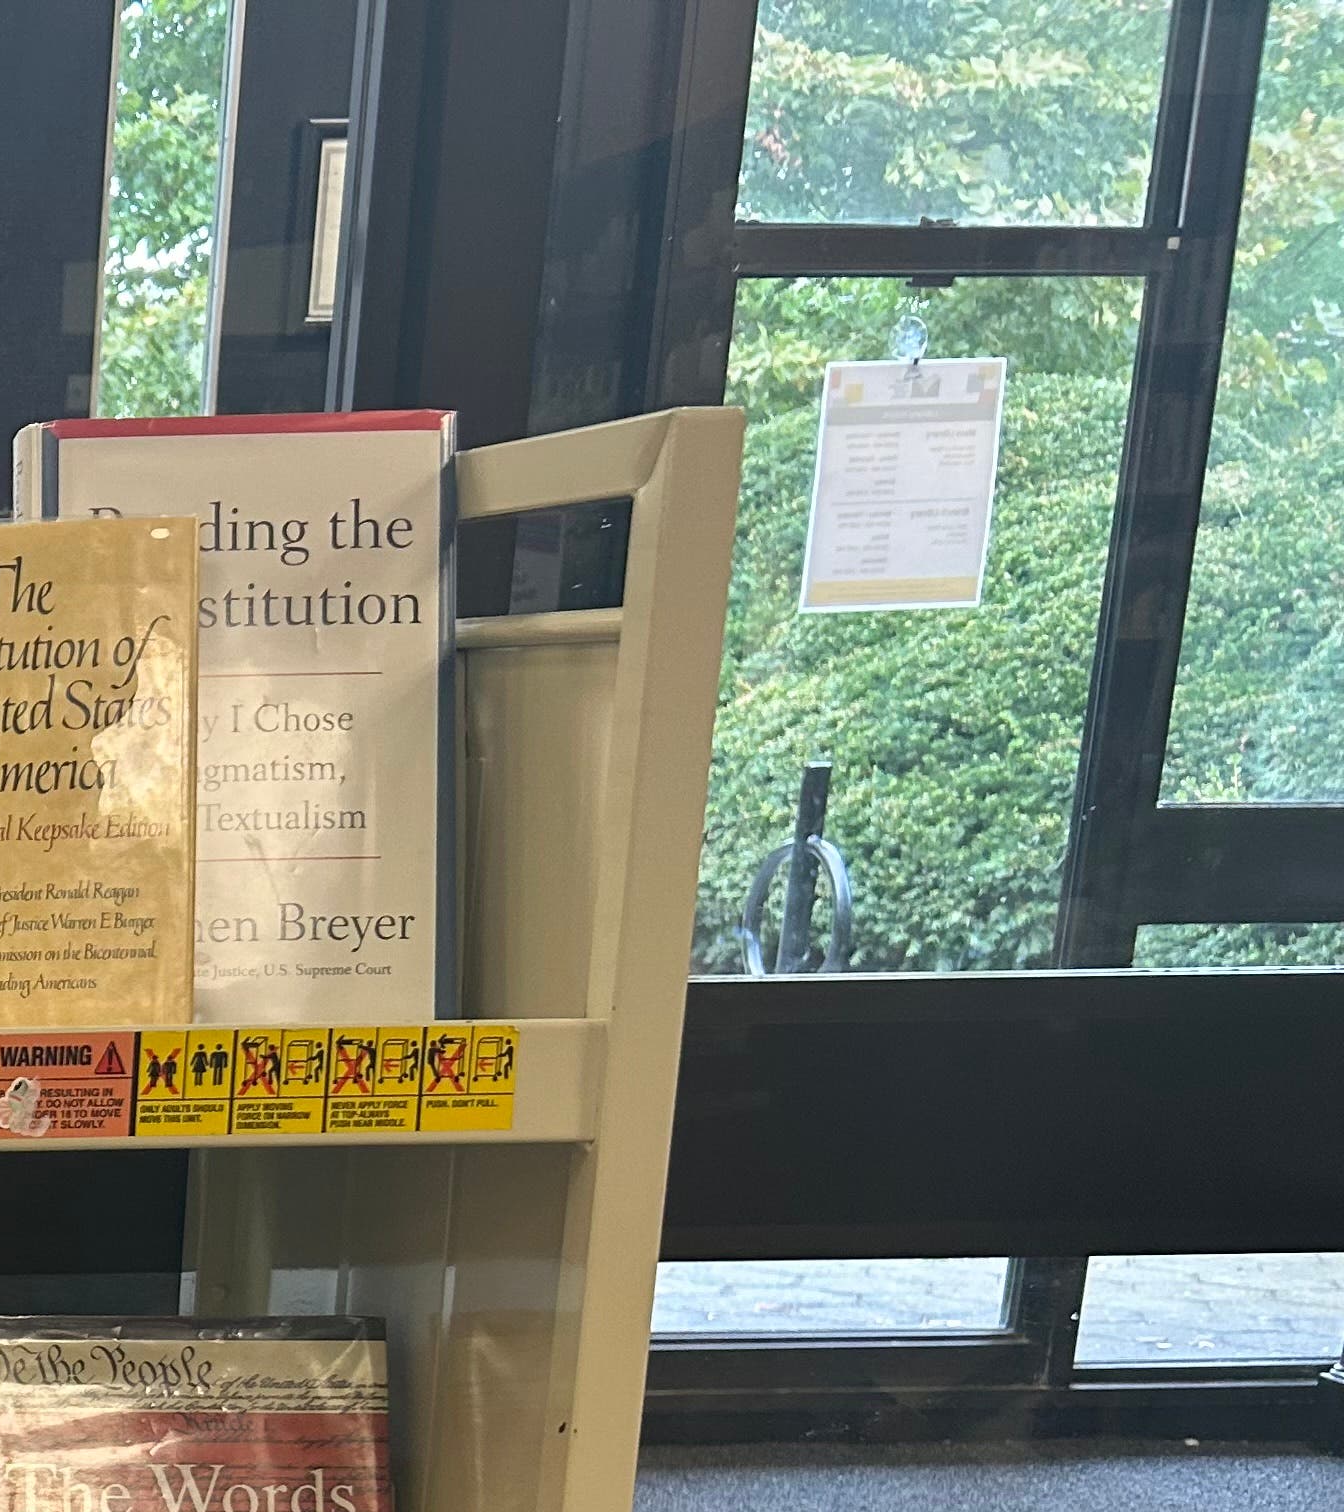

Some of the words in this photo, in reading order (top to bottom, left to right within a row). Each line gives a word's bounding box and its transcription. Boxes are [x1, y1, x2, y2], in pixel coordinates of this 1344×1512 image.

[113, 614, 171, 691] of
[62, 678, 172, 731] States
[203, 800, 367, 832] Textualism
[277, 902, 415, 953] Breyer
[212, 965, 260, 978] Justice,
[264, 963, 288, 977] U.S.
[296, 963, 352, 978] Supreme
[355, 962, 392, 976] Court
[0, 1044, 92, 1067] WARNING
[40, 1088, 99, 1097] RESULTING
[102, 1088, 113, 1096] IN
[46, 1100, 61, 1108] DO
[62, 1099, 85, 1108] NOT
[88, 1098, 124, 1108] ALLOW
